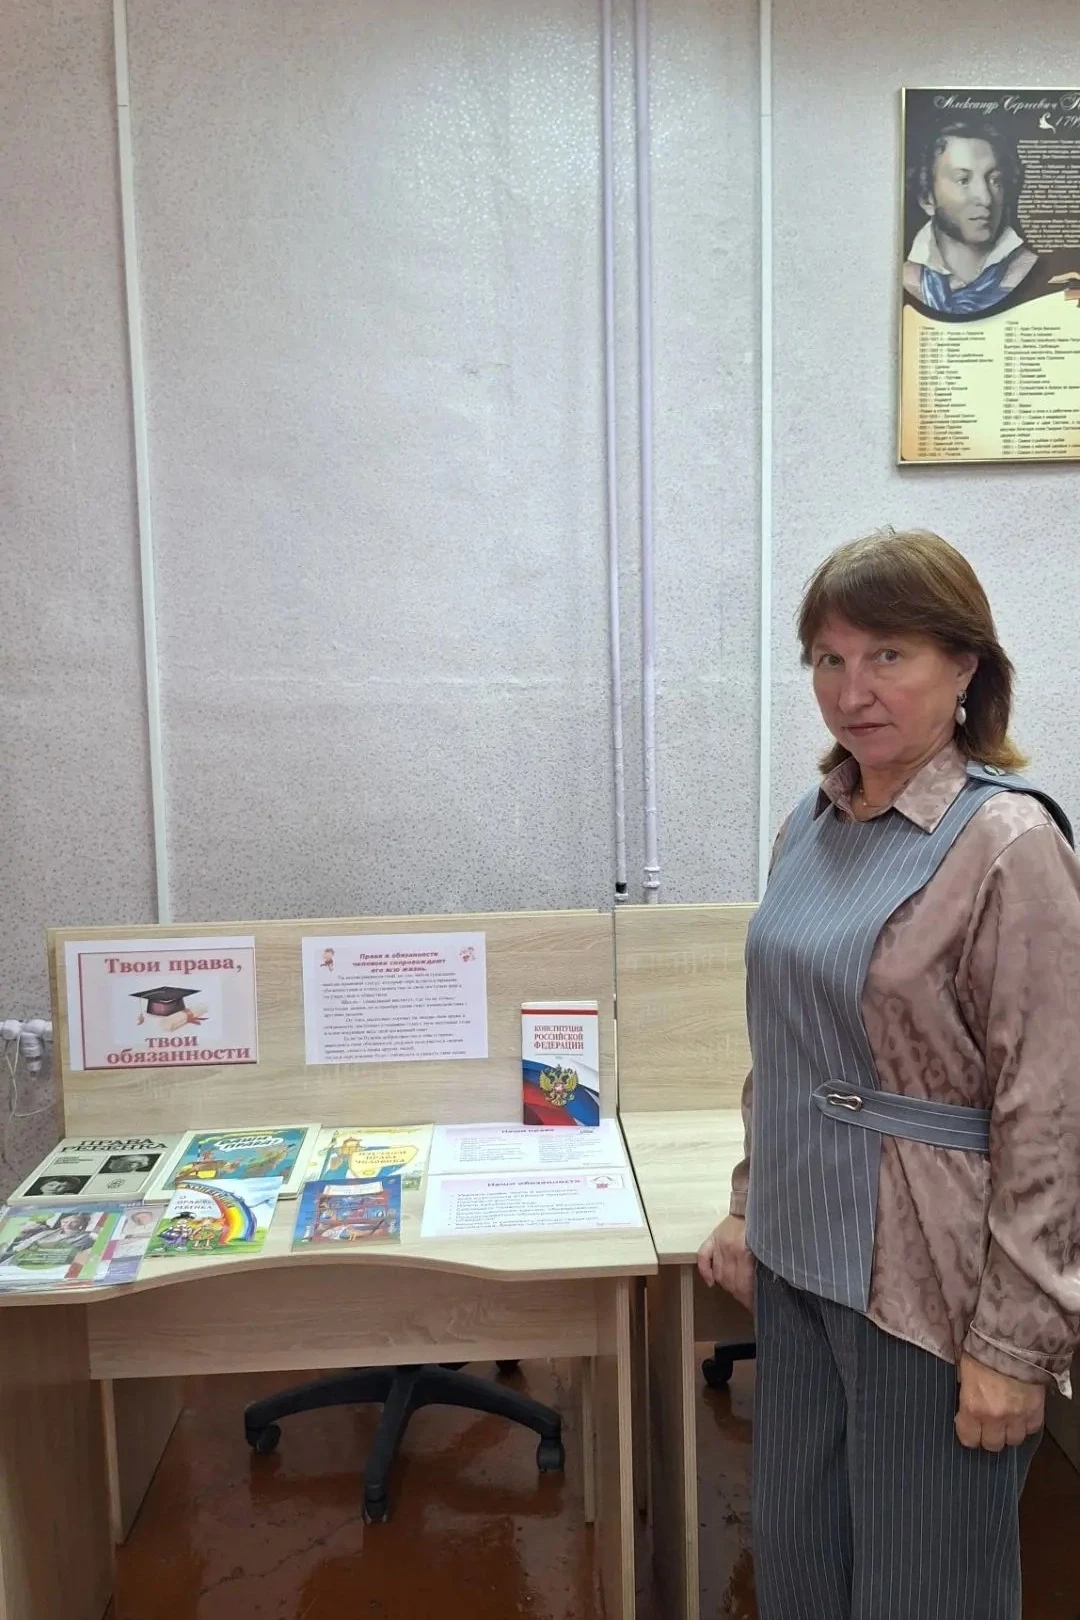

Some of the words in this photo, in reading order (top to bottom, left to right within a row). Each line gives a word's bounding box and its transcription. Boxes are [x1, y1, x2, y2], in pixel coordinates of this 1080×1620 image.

[104, 957, 161, 974] Твои
[169, 957, 243, 975] права,
[534, 1025, 584, 1033] КОНСТИТУЦИЯ
[534, 1032, 584, 1041] РОССИЙСКОЙ
[145, 1036, 198, 1049] твои
[533, 1041, 584, 1050] ФЕДЕРАЦИИ
[106, 1047, 250, 1065] обязанности
[80, 1138, 154, 1146] ПРАВА
